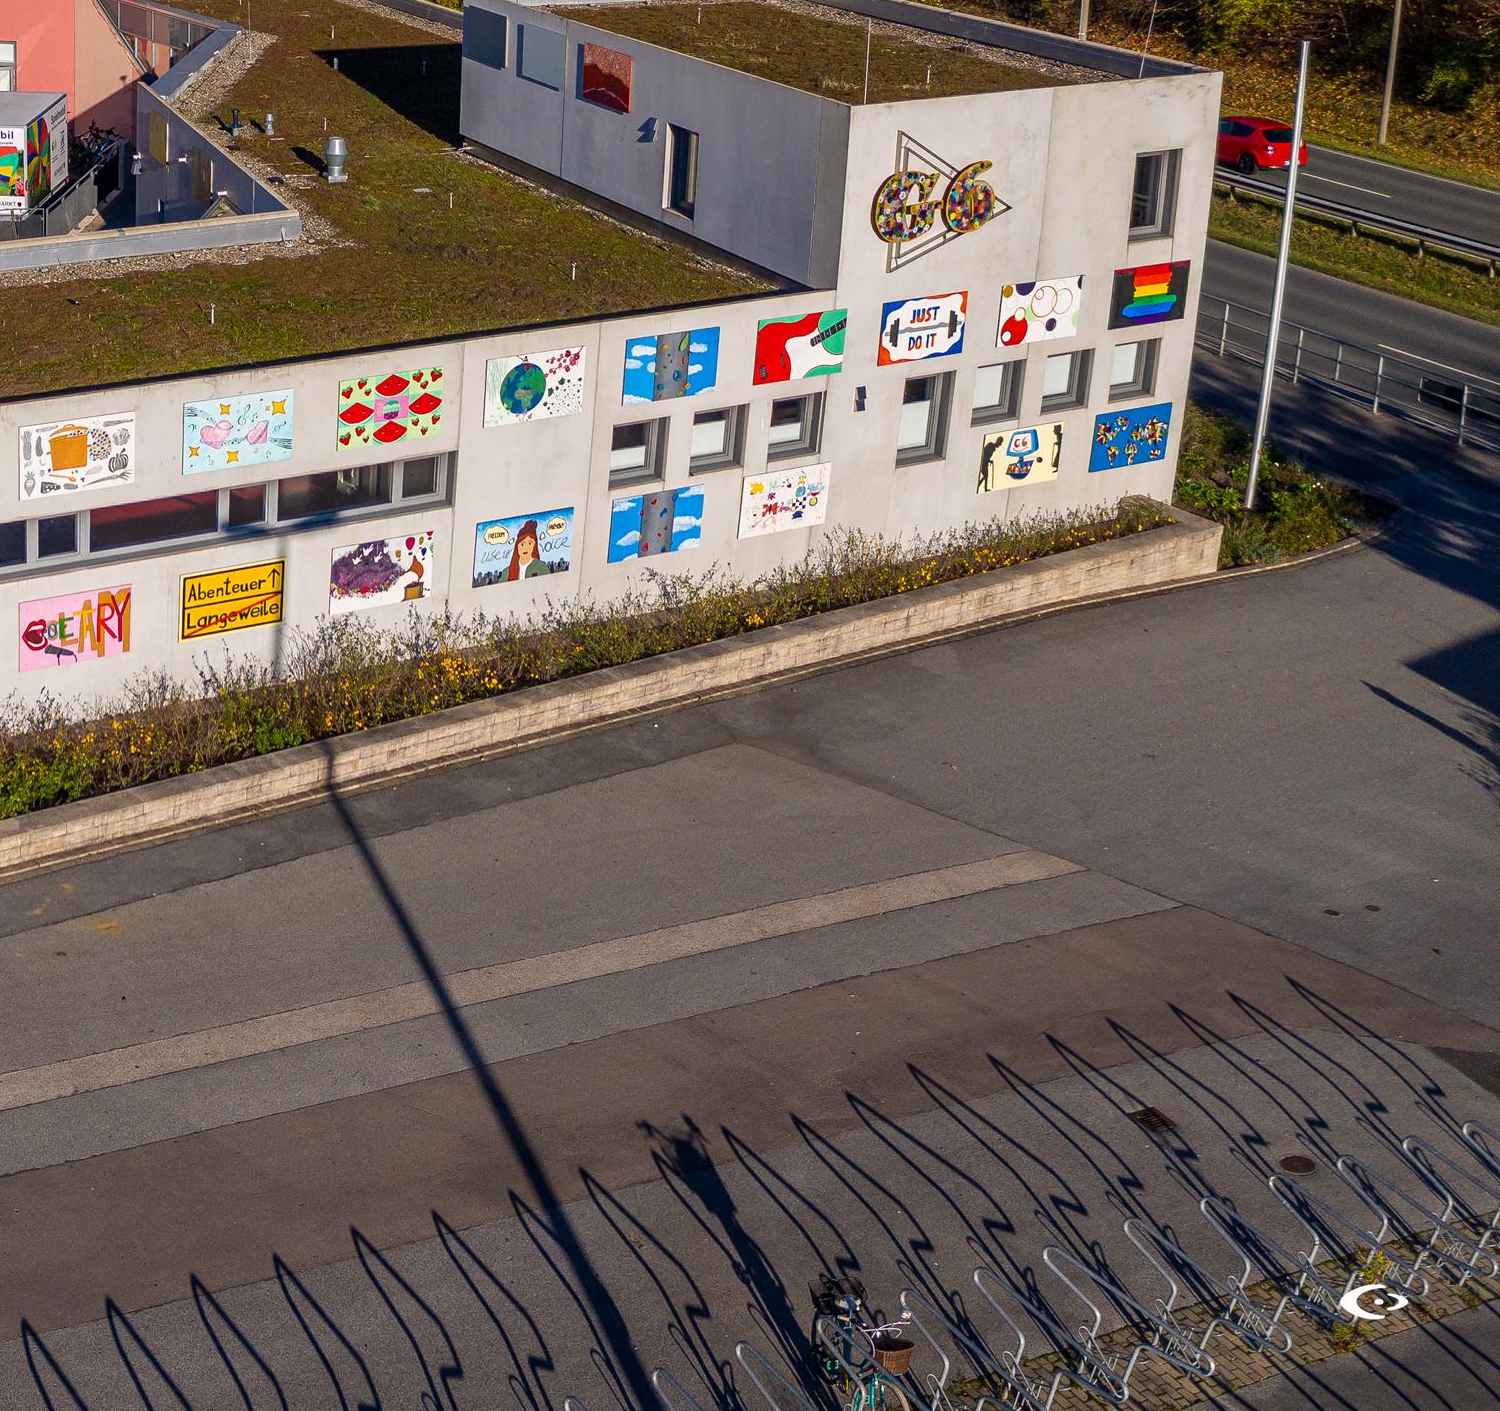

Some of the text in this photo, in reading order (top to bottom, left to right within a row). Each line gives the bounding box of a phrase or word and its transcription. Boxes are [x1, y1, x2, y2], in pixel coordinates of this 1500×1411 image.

[870, 159, 993, 244] G6
[910, 305, 940, 324] JUST
[907, 333, 937, 351] DO IT
[188, 577, 266, 602] Abenteuer
[187, 600, 279, 629] Langeweile
